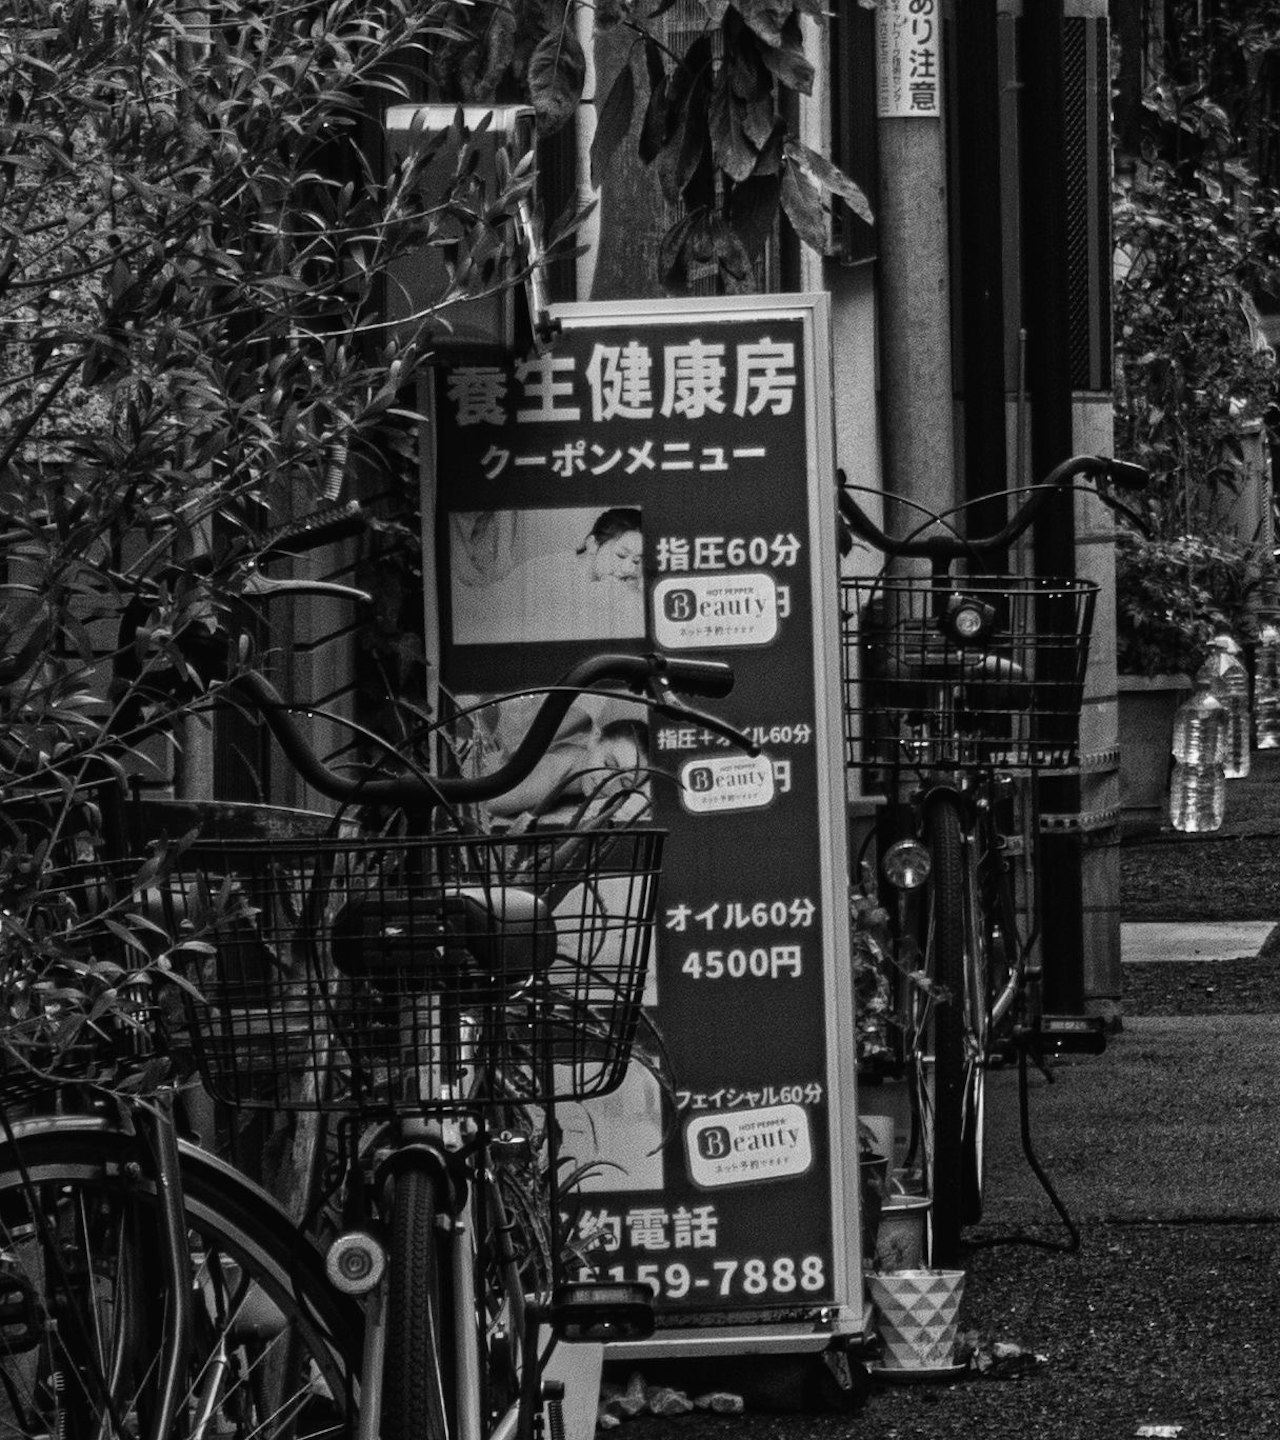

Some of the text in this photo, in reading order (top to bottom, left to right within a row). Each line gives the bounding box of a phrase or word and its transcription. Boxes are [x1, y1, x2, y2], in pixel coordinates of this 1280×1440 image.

[447, 336, 797, 427] 養生健康房
[479, 439, 766, 480] クーポンメニュー
[655, 532, 802, 572] 指圧60分
[663, 588, 767, 623] Beauty
[688, 766, 766, 793] Beauty
[665, 898, 816, 931] オイル60分
[682, 945, 802, 980] 4500円
[675, 1082, 822, 1110] フェイシャル60分
[697, 1125, 799, 1161] Beauty
[559, 1205, 719, 1251] 約電話
